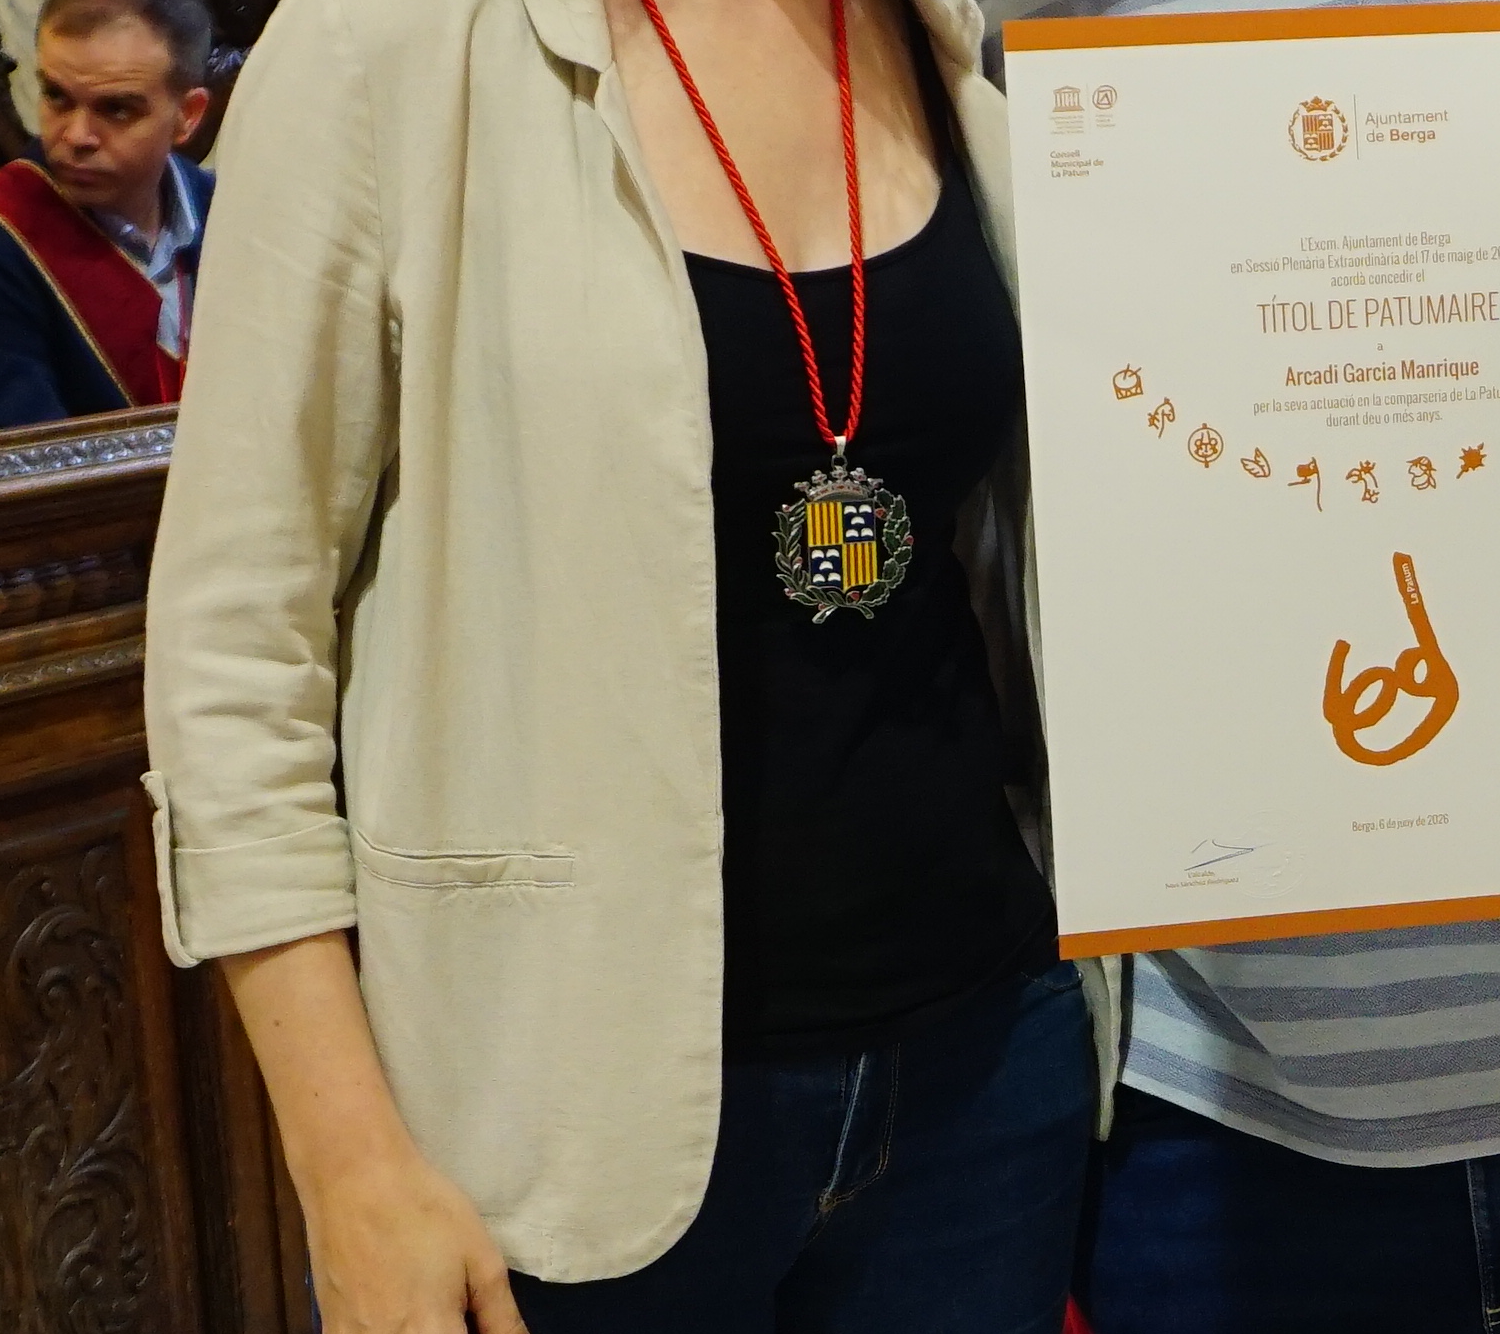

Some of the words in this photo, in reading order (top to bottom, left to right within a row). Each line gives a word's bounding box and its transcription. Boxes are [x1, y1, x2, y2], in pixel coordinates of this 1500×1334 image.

[1365, 110, 1448, 128] Ajuntament
[1366, 130, 1384, 143] de
[1390, 129, 1436, 143] Berga
[1300, 237, 1340, 251] L'Excm.
[1342, 233, 1402, 251] Ajuntament
[1405, 233, 1418, 246] de
[1421, 231, 1451, 247] Berga
[1231, 263, 1243, 274] en
[1245, 258, 1280, 273] Sessió
[1282, 256, 1325, 271] Plenària
[1328, 252, 1400, 269] Extraordinària
[1402, 251, 1419, 265] del
[1421, 249, 1430, 264] 17
[1432, 250, 1445, 263] de
[1447, 249, 1474, 265] maig
[1476, 247, 1489, 261] de
[1331, 272, 1366, 287] acordà
[1369, 270, 1413, 284] concedir
[1416, 269, 1425, 282] el
[1257, 295, 1322, 334] TÍTOL
[1328, 299, 1359, 330] DE
[1364, 291, 1500, 328] PATUMAIRE
[1377, 342, 1384, 351] a
[1285, 364, 1338, 386] Arcadi
[1401, 358, 1479, 380] Manrique
[1253, 400, 1269, 416] per
[1273, 399, 1282, 412] la
[1285, 400, 1308, 411] seva
[1310, 394, 1355, 410] actuació
[1357, 396, 1370, 407] en
[1373, 393, 1382, 406] la
[1384, 389, 1447, 408] comparseria
[1450, 388, 1462, 402] de
[1465, 387, 1476, 400] La
[1326, 411, 1360, 427] durant
[1362, 410, 1381, 425] deu
[1384, 413, 1390, 424] o
[1392, 409, 1414, 424] més
[1416, 409, 1443, 426] anys.
[1410, 593, 1419, 604] La
[1379, 819, 1385, 829] 6
[1416, 816, 1426, 826] de
[1427, 813, 1449, 825] 2026
